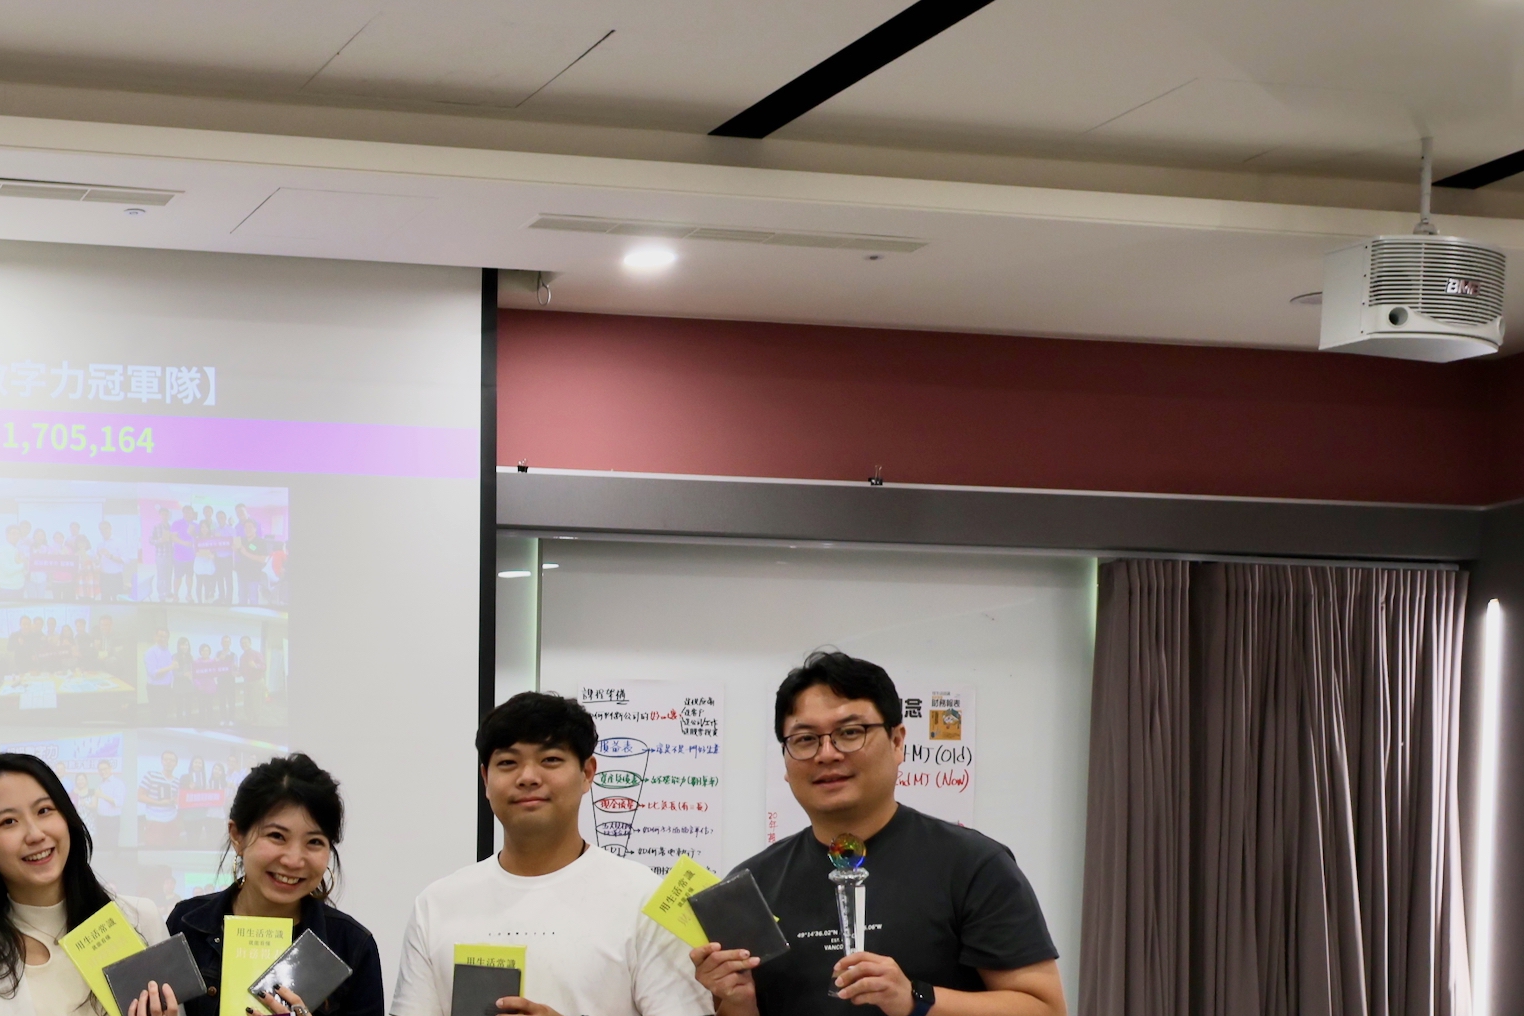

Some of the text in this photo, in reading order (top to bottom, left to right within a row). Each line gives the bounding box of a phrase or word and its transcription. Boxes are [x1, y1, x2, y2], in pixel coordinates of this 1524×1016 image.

[1446, 279, 1481, 296] BMB
[913, 744, 934, 763] MJ
[936, 745, 972, 766] (Old)
[936, 769, 969, 793] (Now)
[237, 928, 284, 939] 用生活常識
